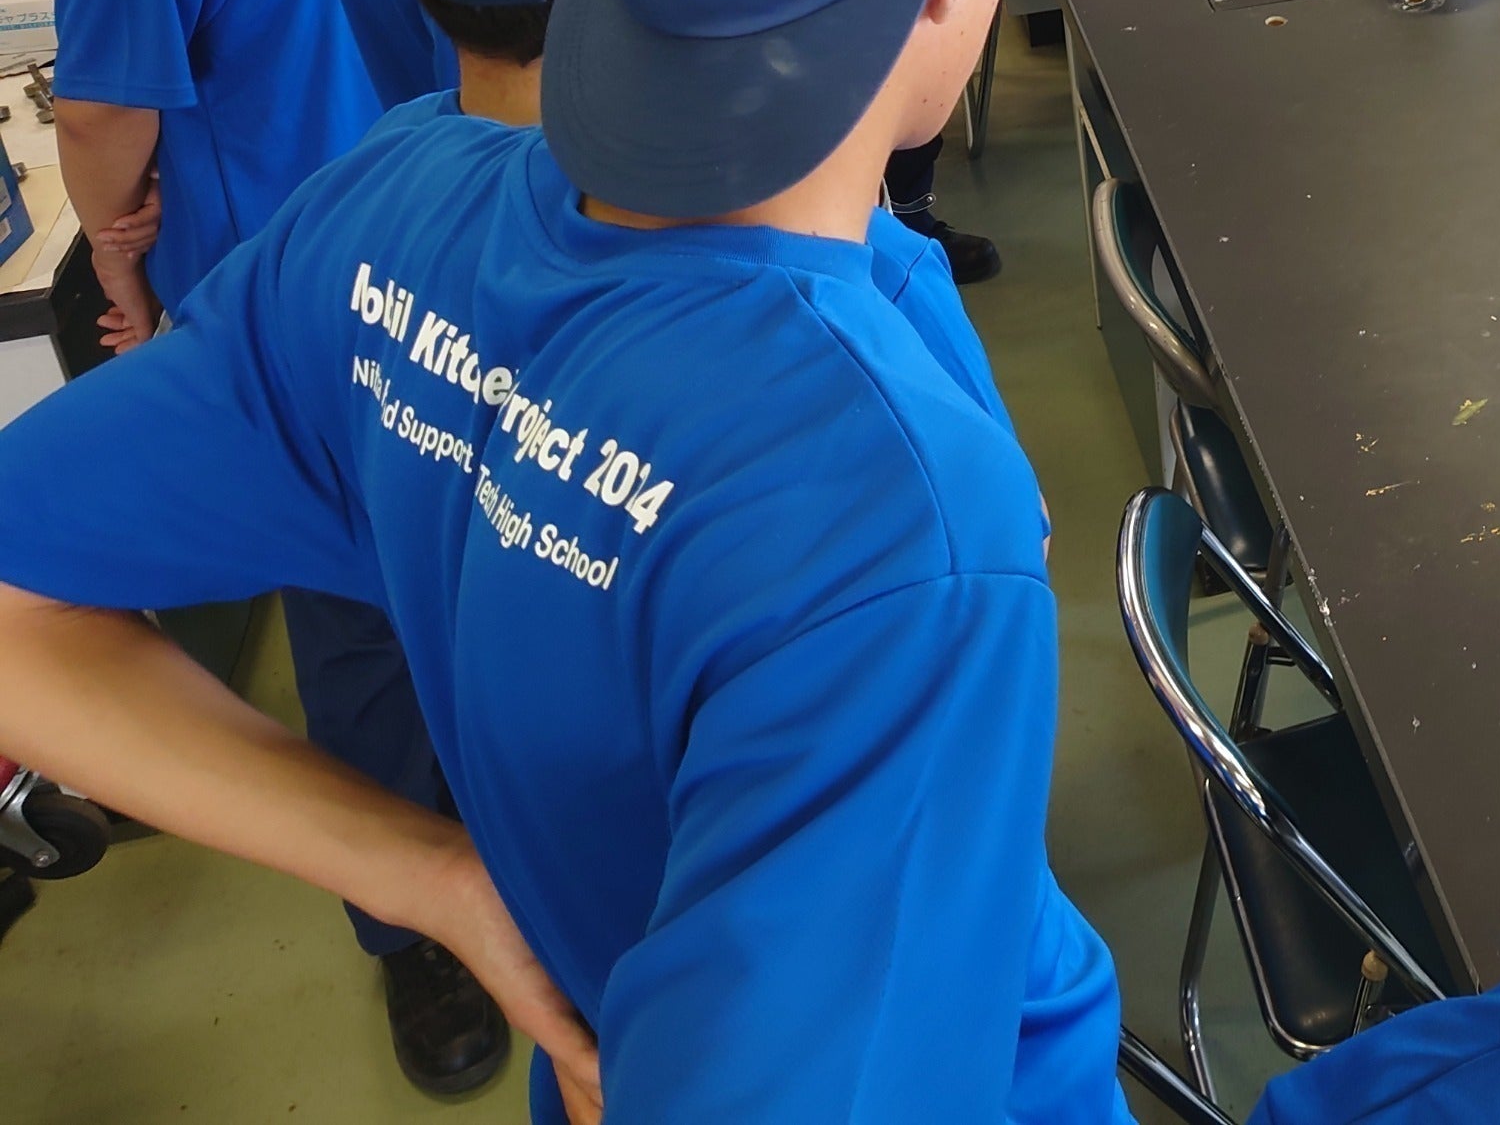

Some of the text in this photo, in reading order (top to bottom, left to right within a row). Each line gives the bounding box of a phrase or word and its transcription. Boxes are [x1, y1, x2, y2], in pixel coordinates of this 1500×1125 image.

[397, 406, 474, 474] Support
[491, 494, 533, 549] High
[535, 523, 619, 591] School
